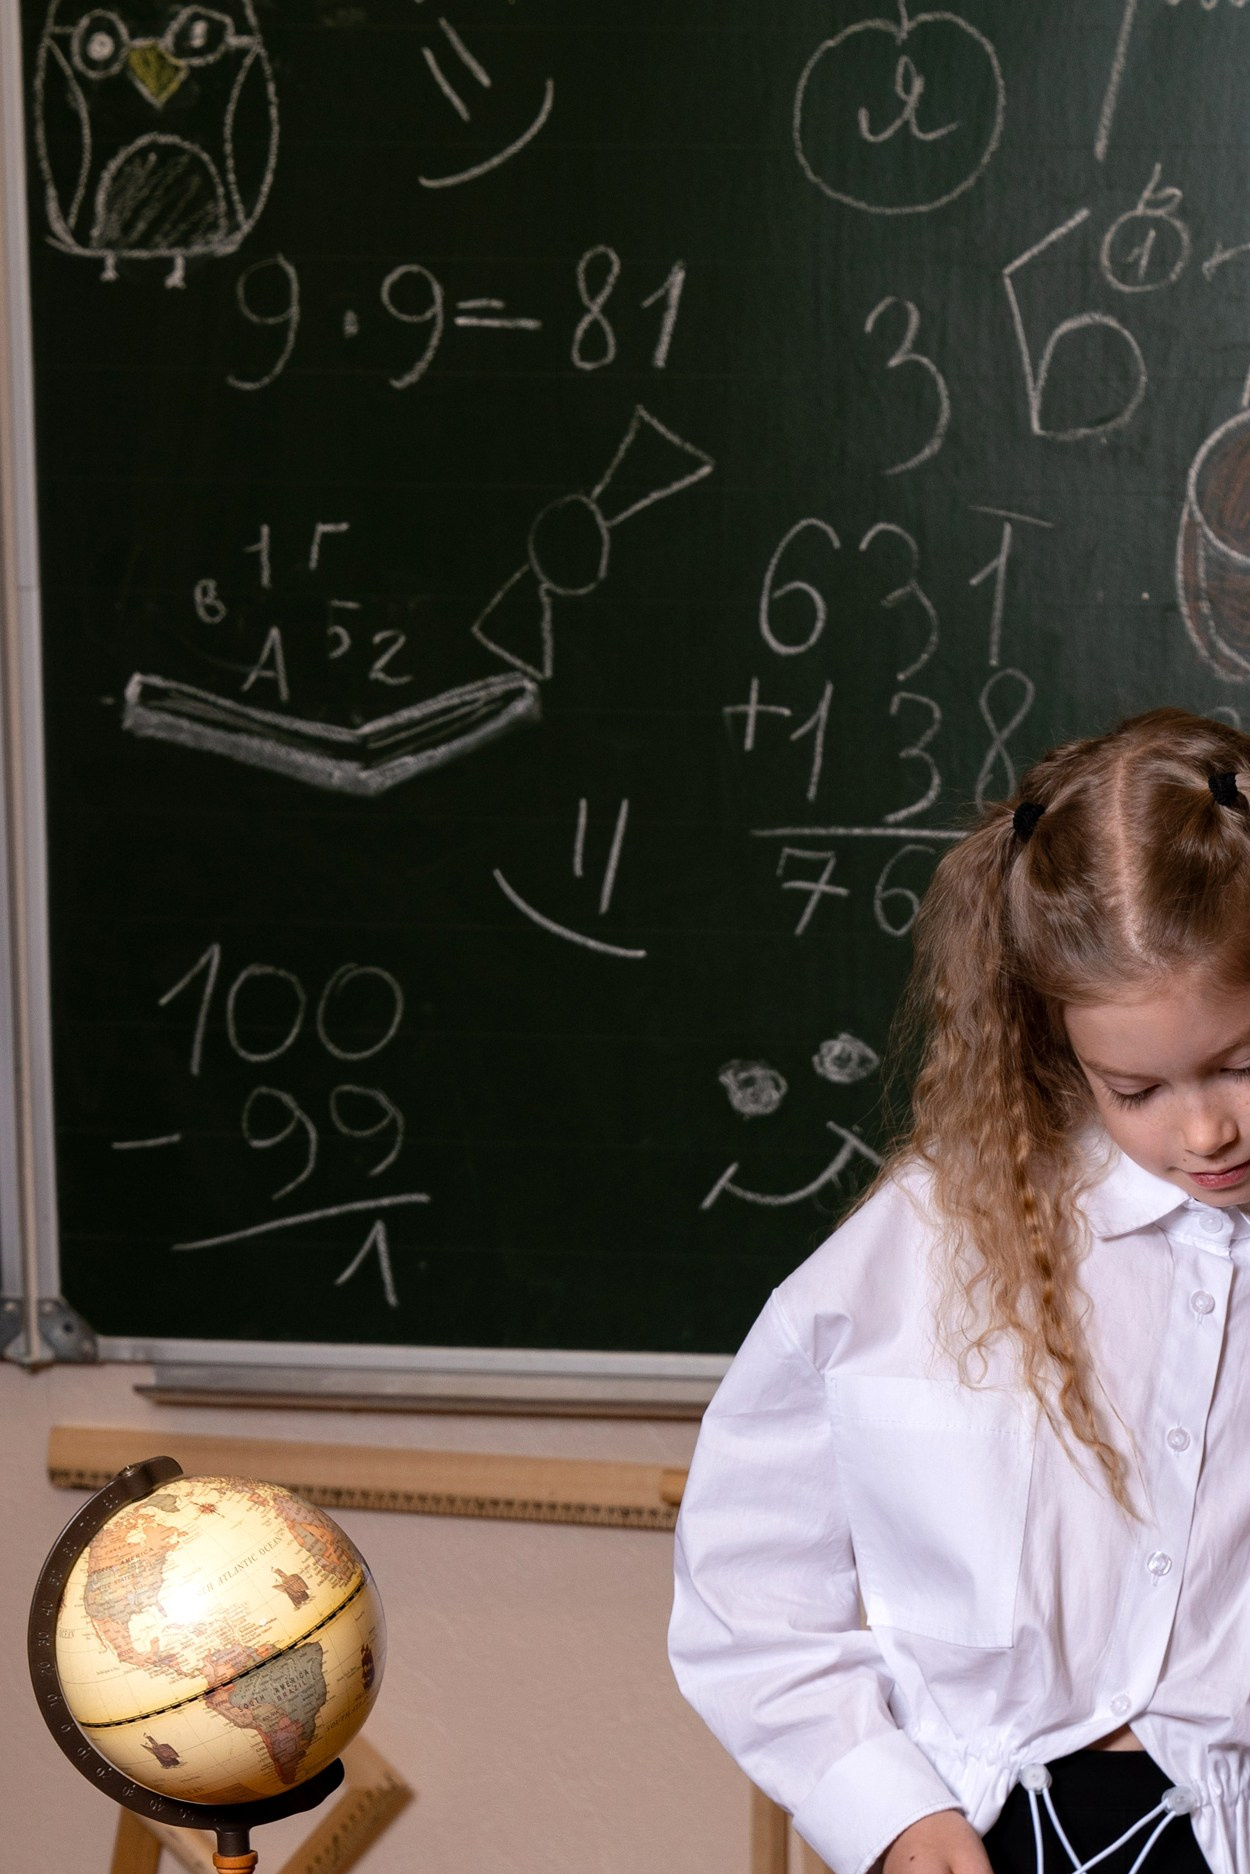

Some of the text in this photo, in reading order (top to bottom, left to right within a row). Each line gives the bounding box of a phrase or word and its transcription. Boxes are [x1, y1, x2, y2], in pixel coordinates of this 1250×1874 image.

[157, 941, 404, 1077] 100
[335, 1219, 399, 1308] 1
[216, 1534, 284, 1588] ATLANTIC OCEAN
[273, 1668, 311, 1695] AMERICA
[275, 1681, 308, 1702] BRAZIL
